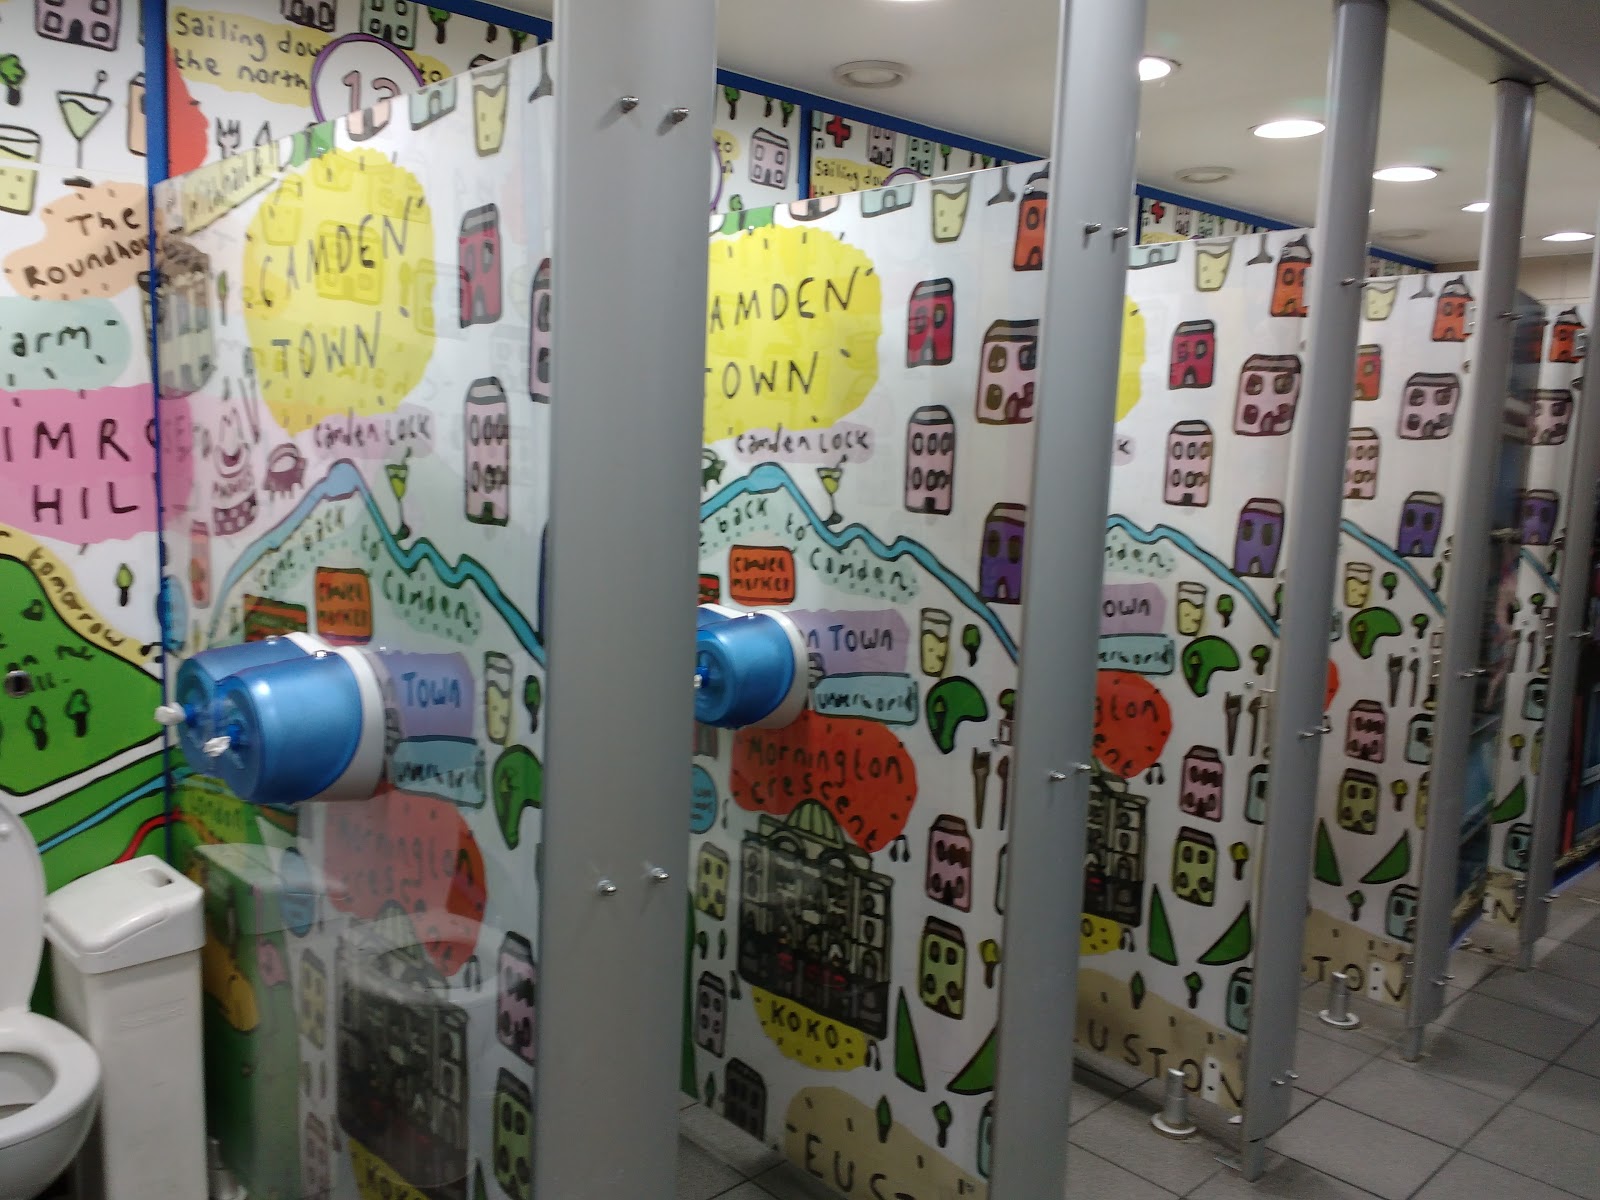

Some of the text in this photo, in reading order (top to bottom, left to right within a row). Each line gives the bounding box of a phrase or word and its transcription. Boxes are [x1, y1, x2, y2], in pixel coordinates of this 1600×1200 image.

[174, 12, 267, 62] Sailing
[173, 48, 222, 76] the
[237, 64, 311, 91] north
[66, 207, 140, 236] The
[260, 197, 413, 307] CAMDEN
[709, 266, 860, 333] AMDEN
[270, 311, 382, 380] TOWN
[705, 351, 819, 399] OWN
[770, 1001, 840, 1049] KOKO
[804, 1132, 916, 1200] EUS
